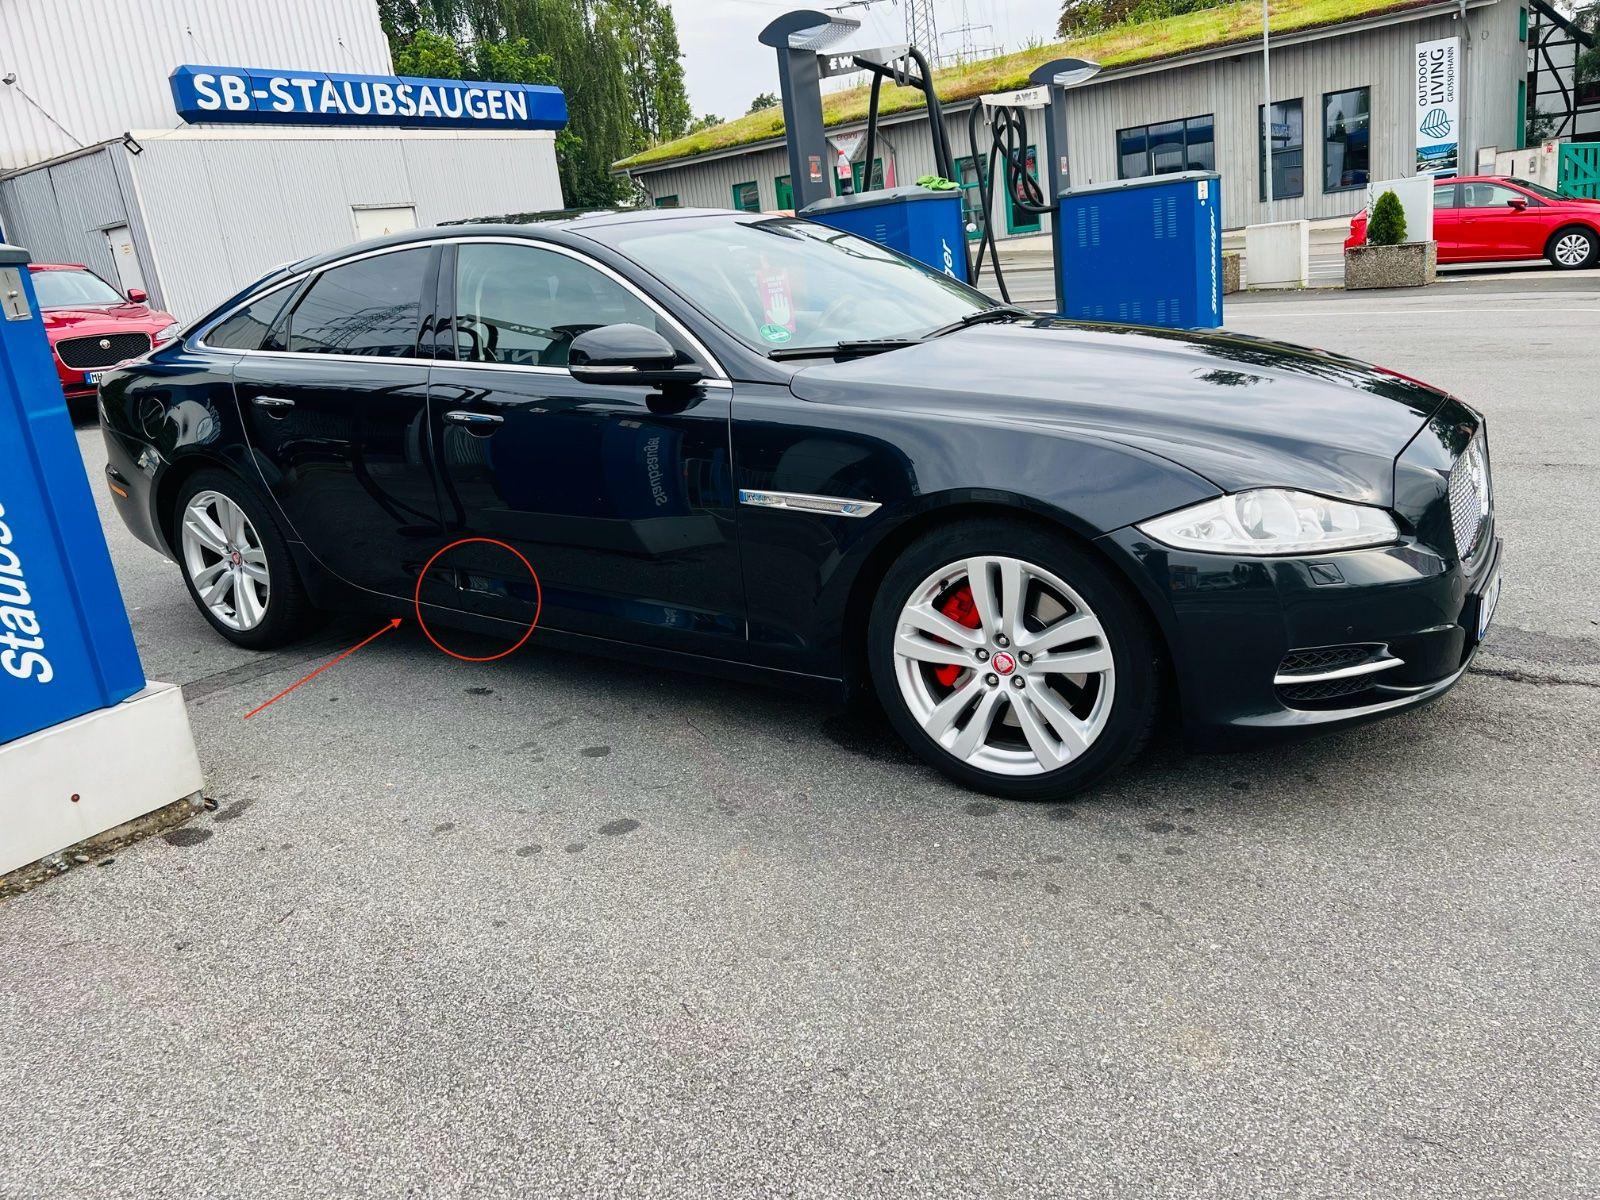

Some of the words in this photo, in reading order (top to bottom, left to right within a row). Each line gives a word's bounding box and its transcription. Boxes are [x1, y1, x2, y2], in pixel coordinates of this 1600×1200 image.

[193, 73, 528, 120] SB-STAUBSAUGEN
[1418, 50, 1428, 107] OUTDOOR
[1430, 48, 1444, 105] LIVING
[1447, 46, 1455, 103] GROSSJOHANN
